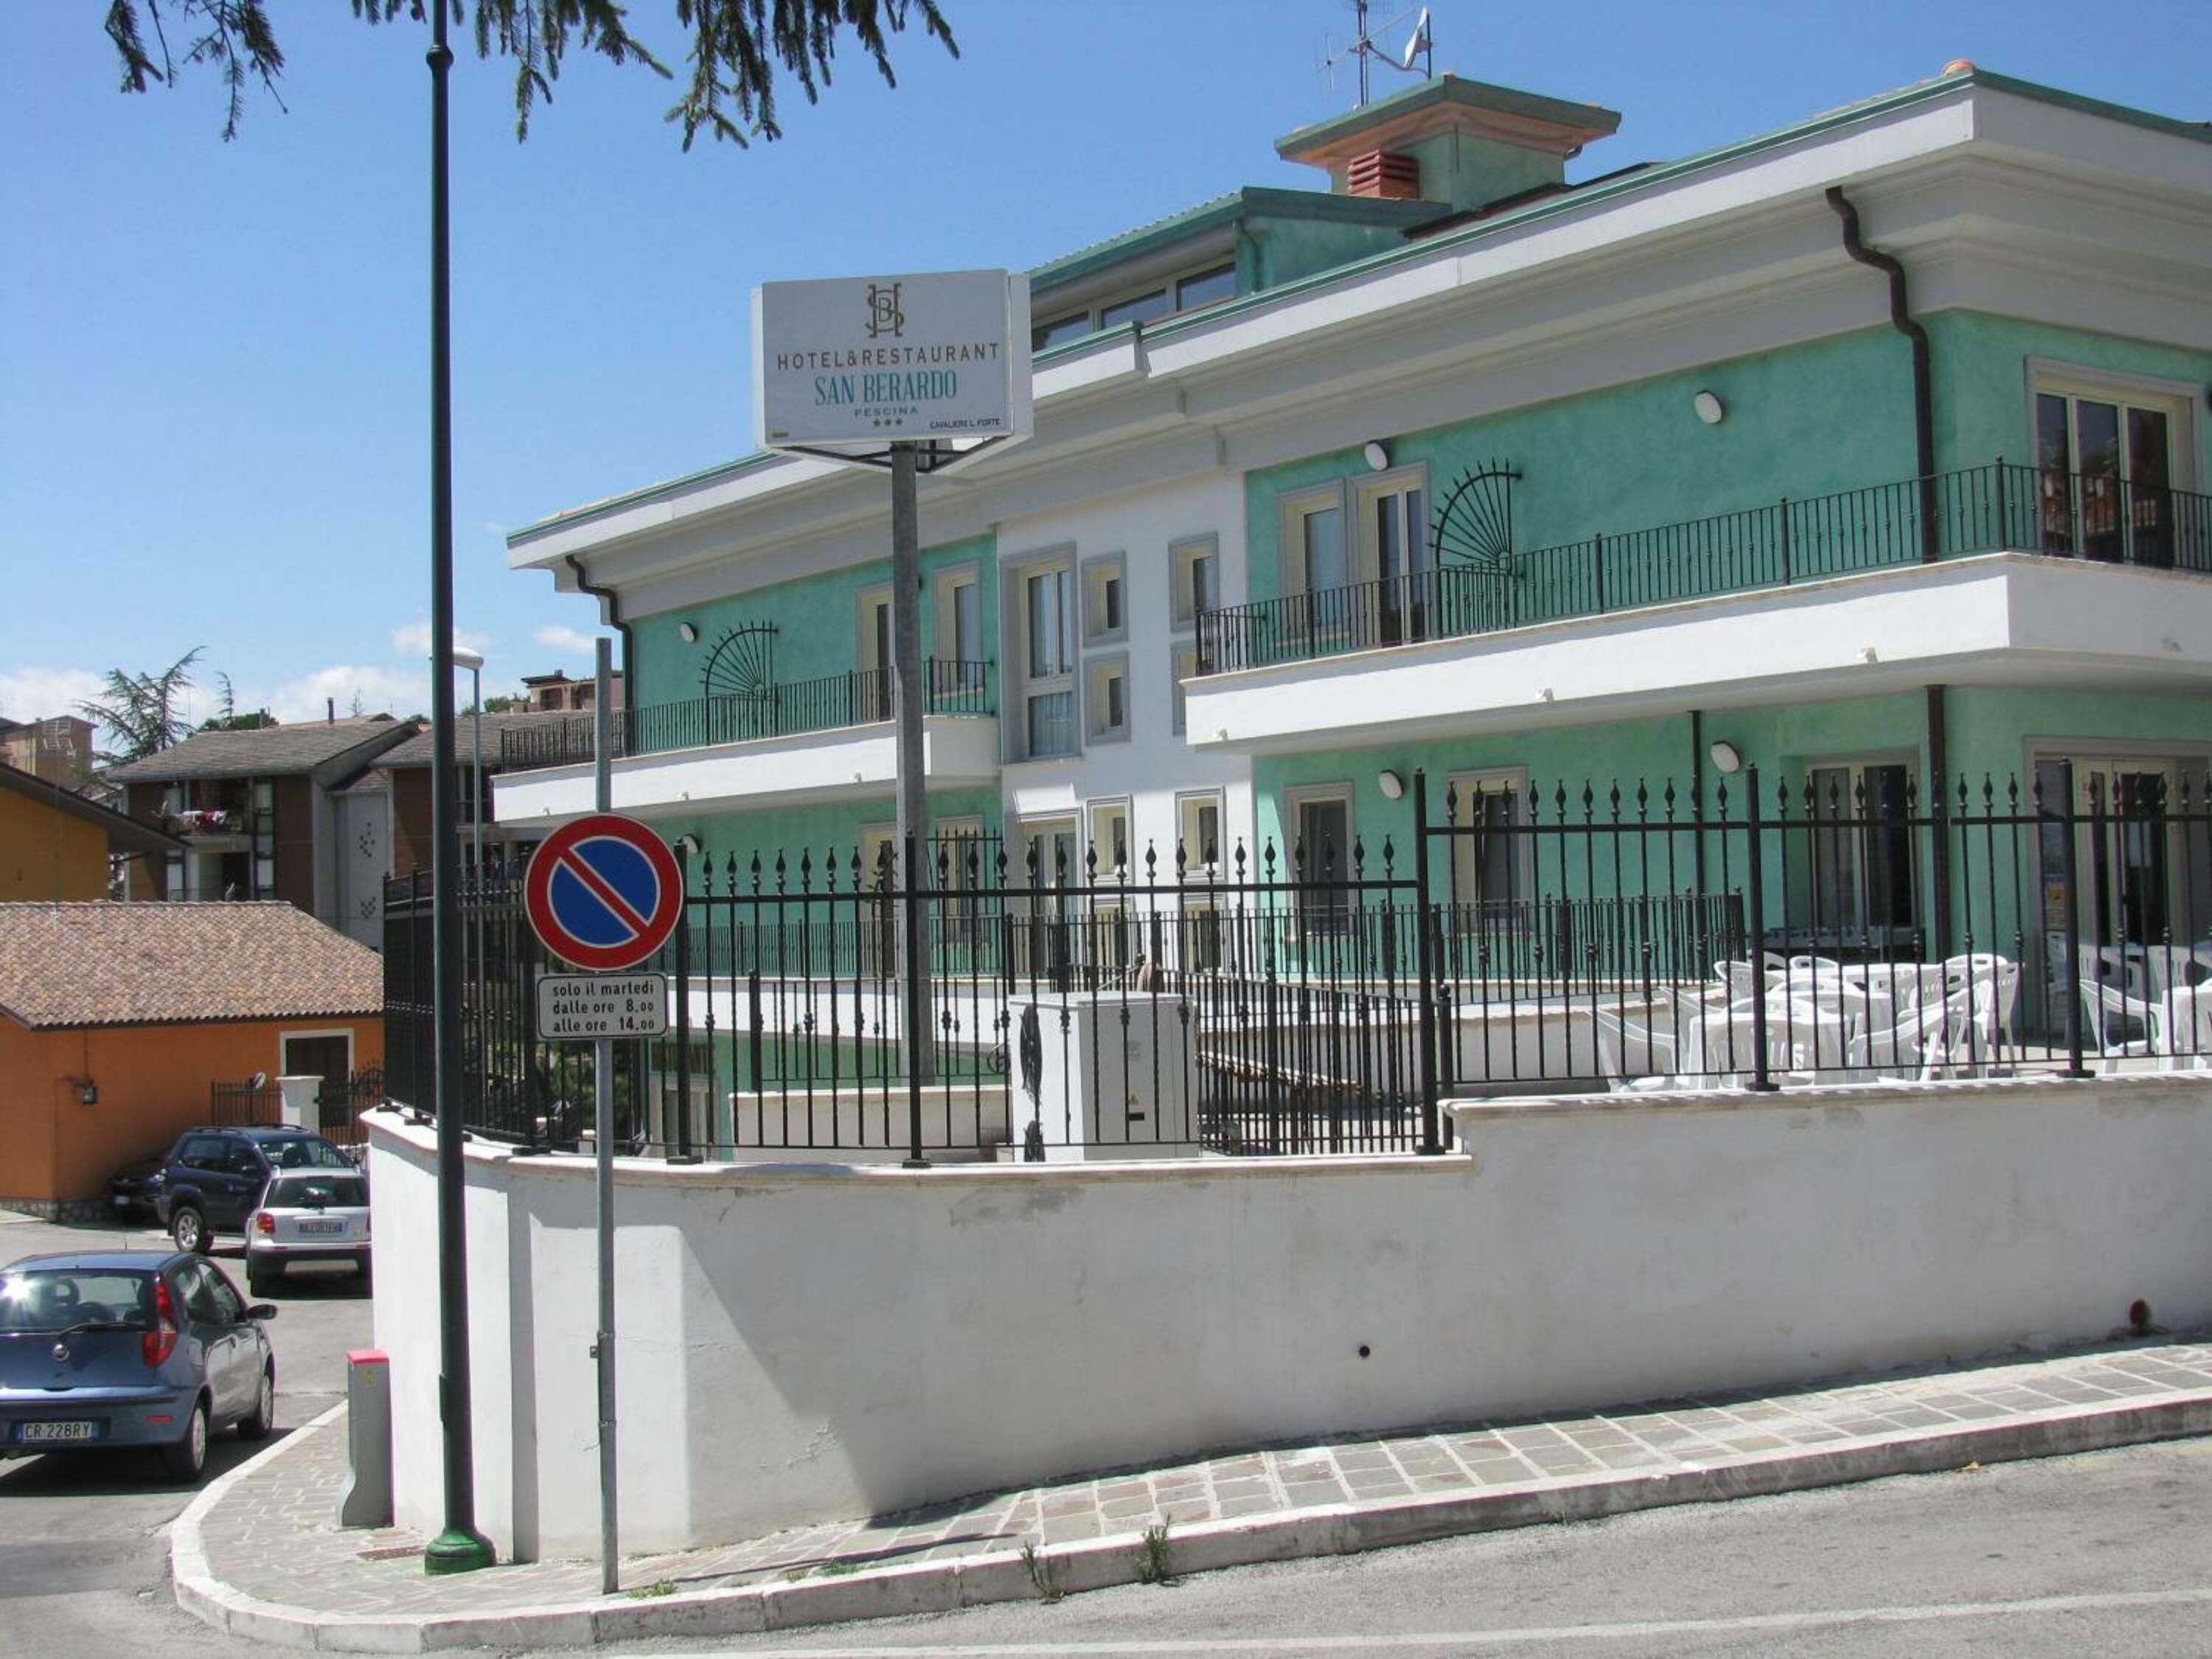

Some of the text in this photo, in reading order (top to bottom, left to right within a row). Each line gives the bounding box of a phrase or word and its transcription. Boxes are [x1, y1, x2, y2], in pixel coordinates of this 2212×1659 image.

[815, 369, 956, 406] SAN BERARDO
[854, 406, 918, 417] PESCINA
[553, 979, 654, 996] solo il martedi
[553, 999, 654, 1015] dalle ore 8.00
[554, 1016, 654, 1032] alle ore 14.00
[25, 1425, 42, 1438] CR
